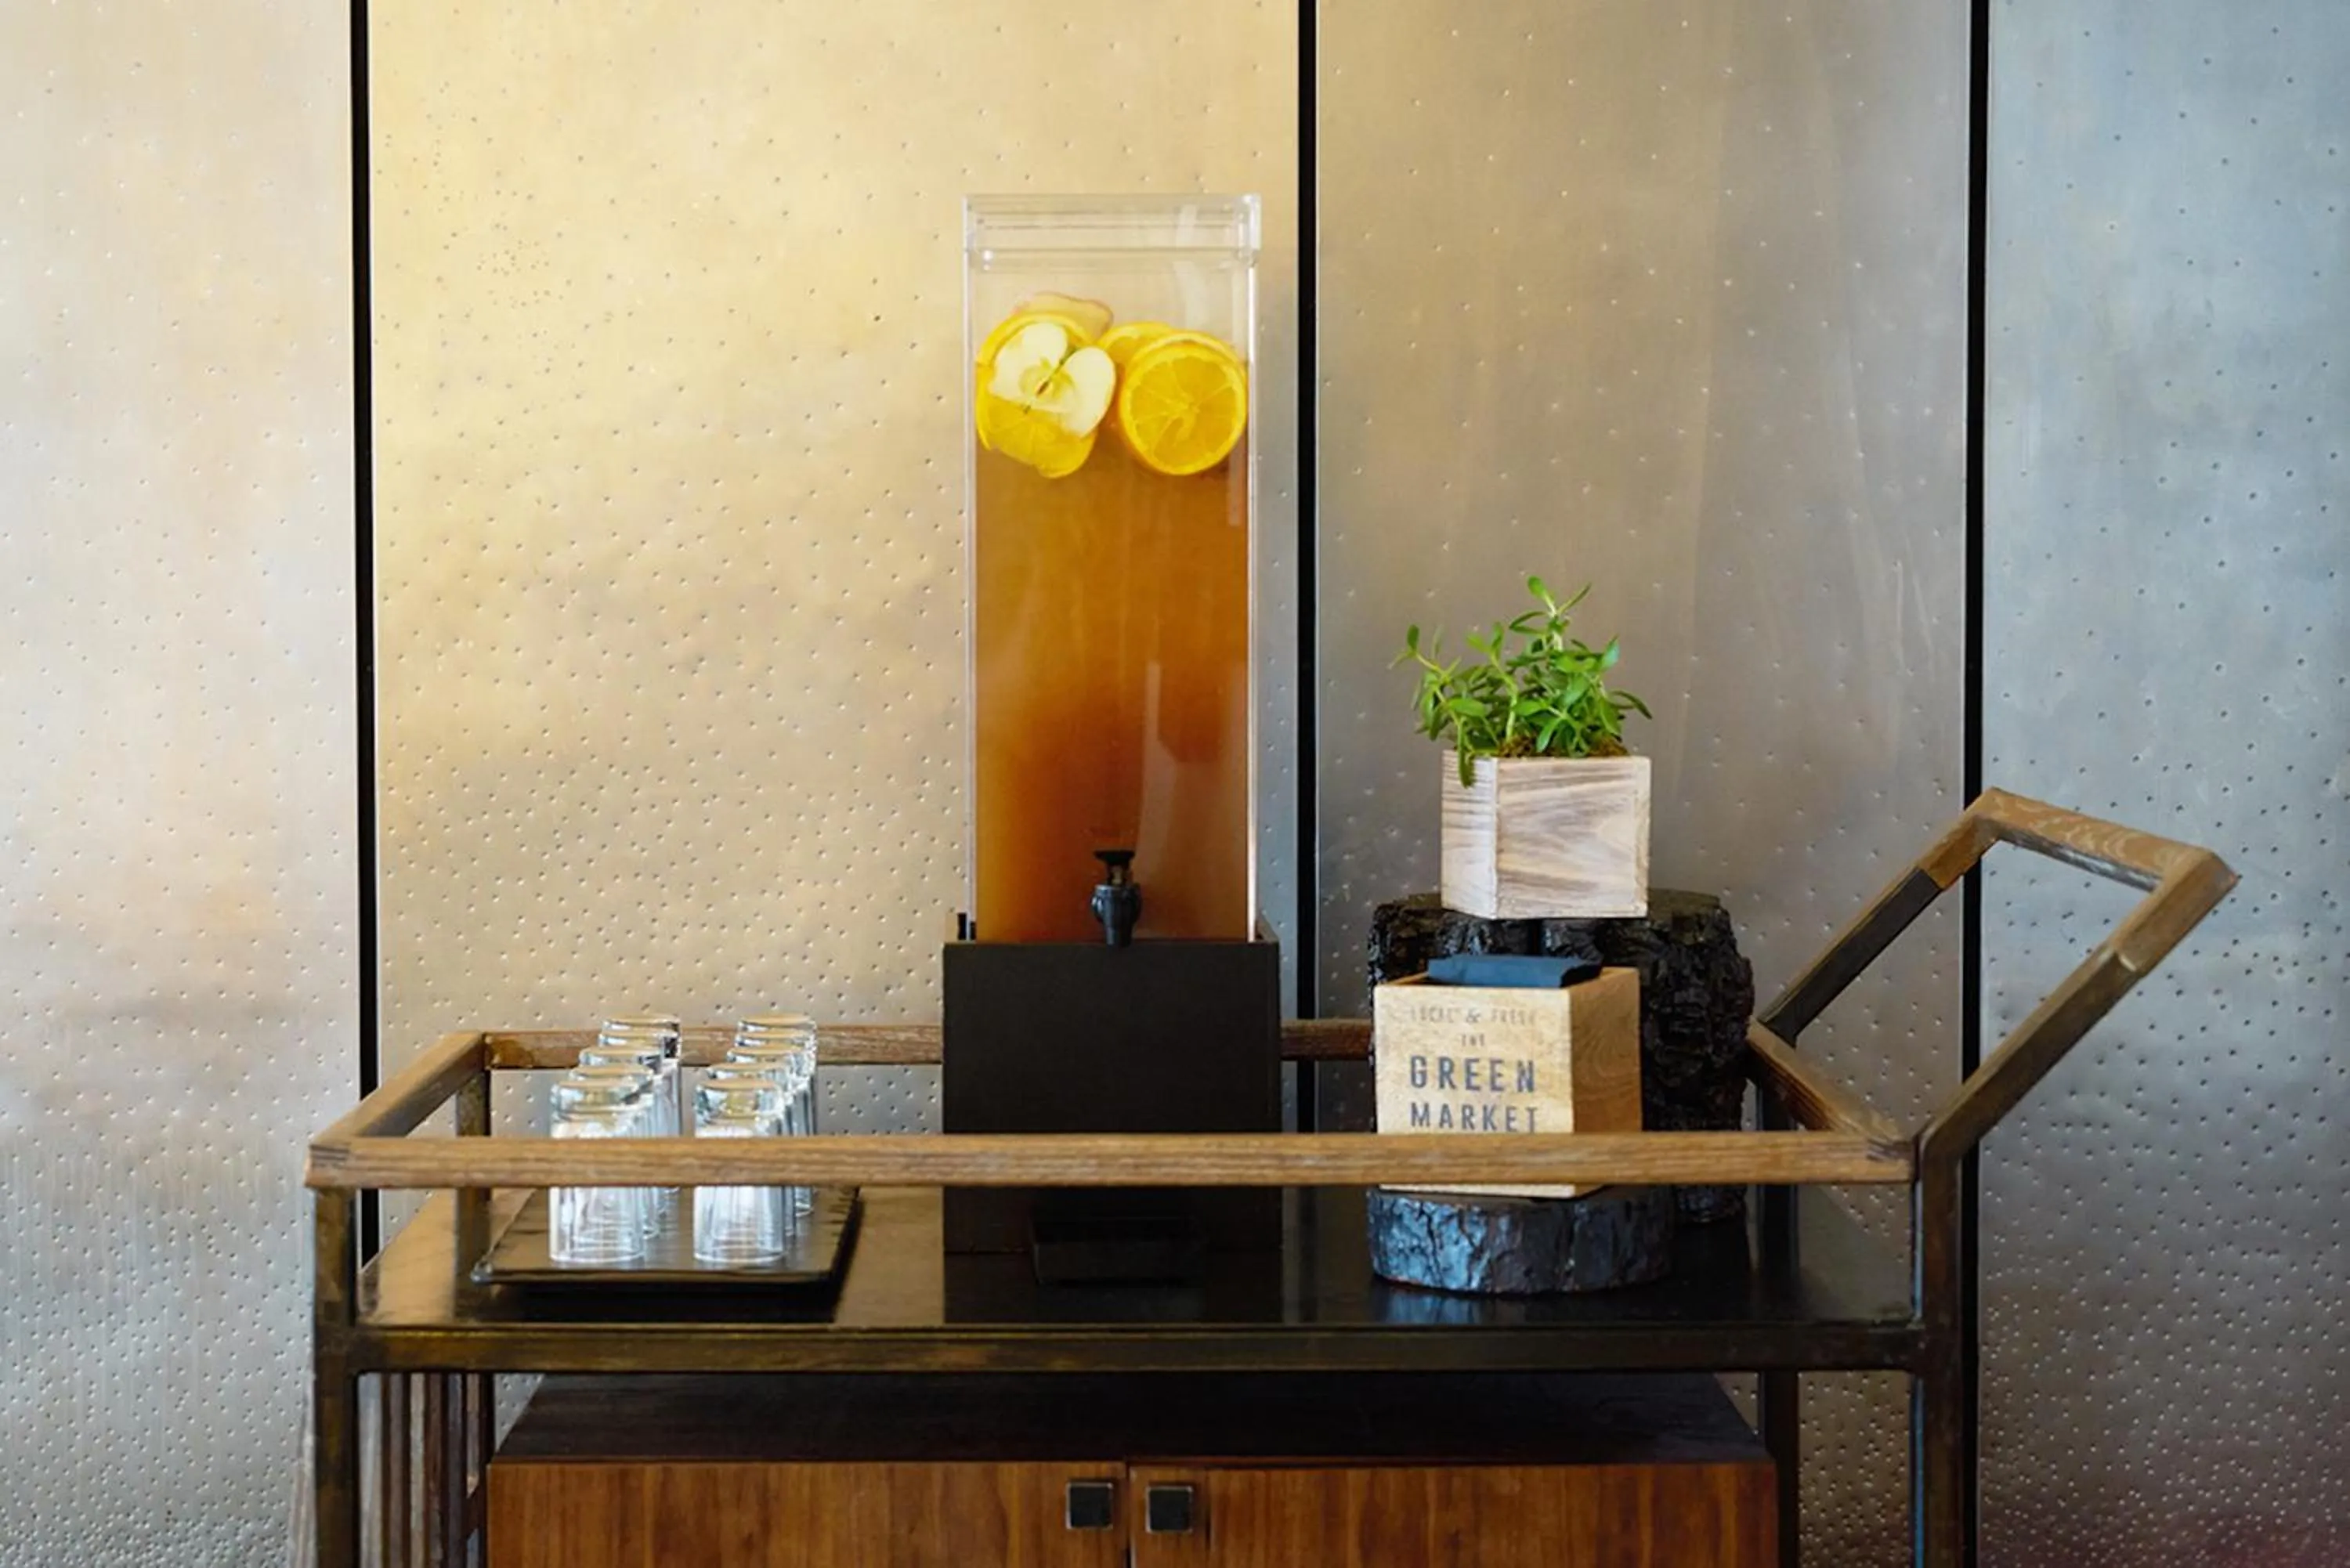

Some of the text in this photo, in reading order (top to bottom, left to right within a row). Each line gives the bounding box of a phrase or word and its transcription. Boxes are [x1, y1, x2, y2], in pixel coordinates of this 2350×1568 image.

[1466, 1006, 1481, 1024] &
[1410, 1055, 1535, 1093] GREEN
[1410, 1102, 1538, 1133] MARKET
